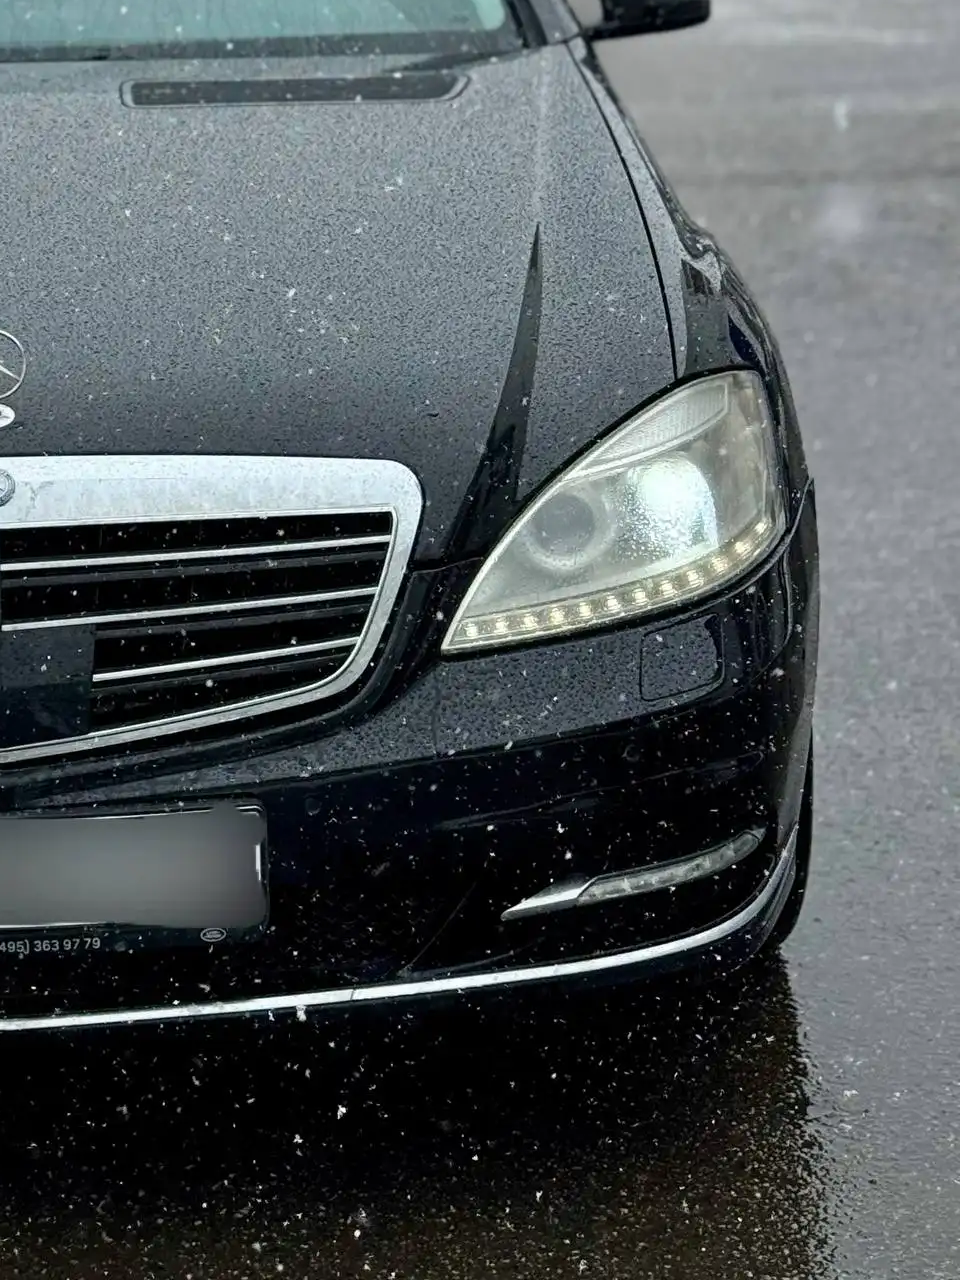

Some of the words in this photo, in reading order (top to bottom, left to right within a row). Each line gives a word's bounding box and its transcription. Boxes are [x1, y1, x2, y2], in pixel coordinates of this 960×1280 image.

[34, 939, 60, 952] 363
[63, 938, 81, 951] 97
[83, 937, 101, 950] 79
